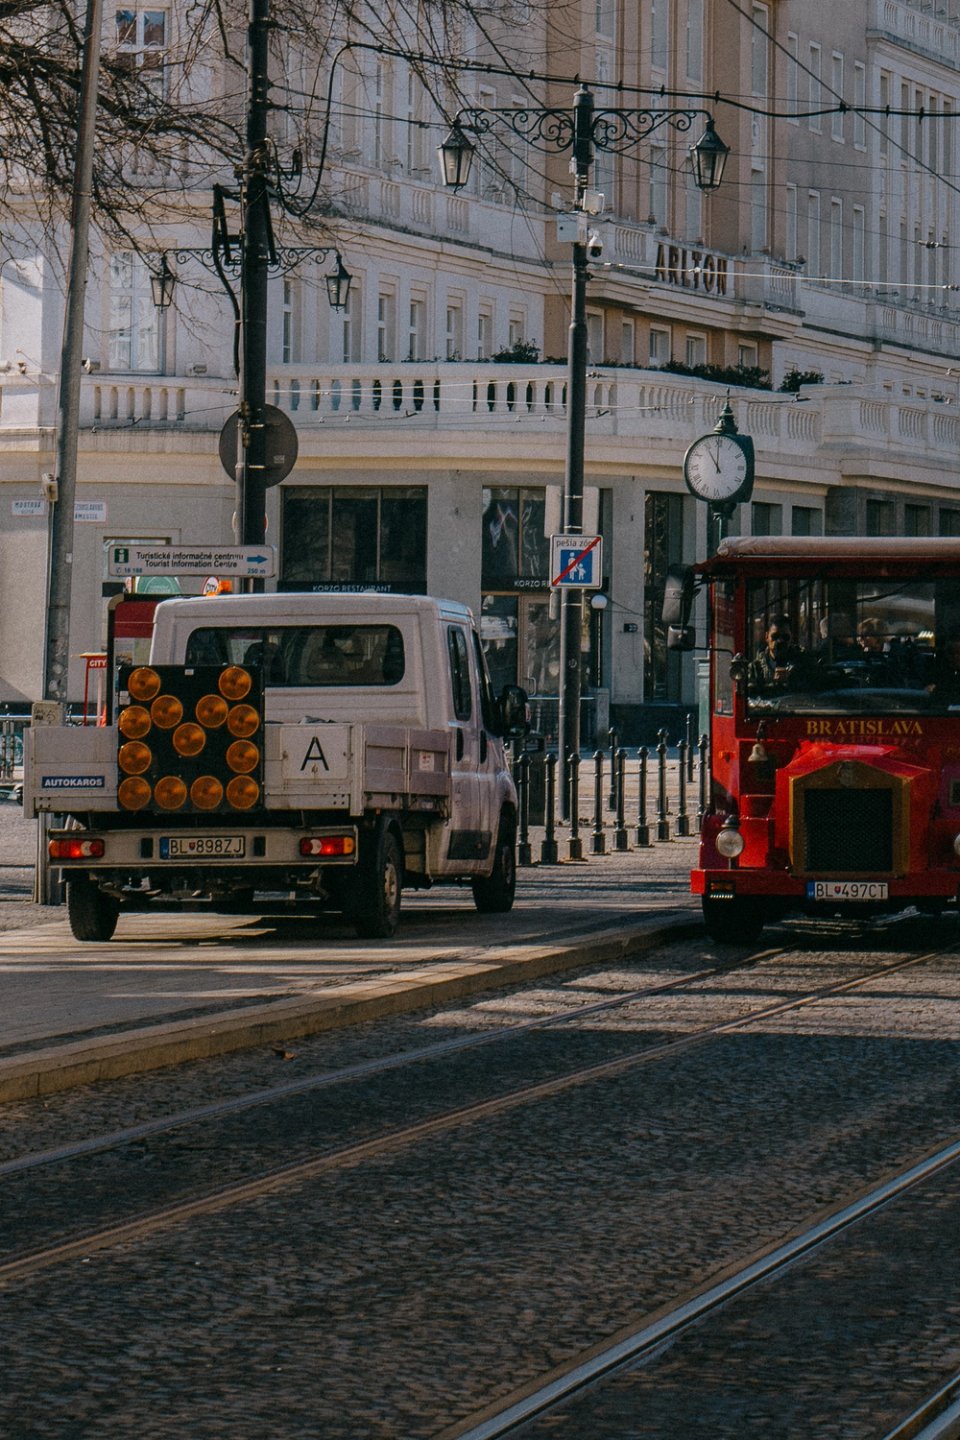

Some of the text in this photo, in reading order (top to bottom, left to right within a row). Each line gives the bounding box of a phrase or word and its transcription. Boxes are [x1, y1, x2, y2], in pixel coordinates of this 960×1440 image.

[556, 538, 577, 548] pešia
[136, 551, 171, 560] Turistické
[172, 551, 212, 560] informačné
[145, 560, 238, 568] Tourist Information Centre
[312, 584, 392, 592] KORZO RESTAURANT
[514, 580, 540, 588] KORZO
[89, 659, 107, 667] CITY
[806, 720, 924, 735] BRATISLAVA
[300, 735, 330, 771] A
[44, 777, 103, 787] AUTOKAROS
[170, 839, 242, 854] BL 898ZJ
[816, 883, 886, 898] BL 497CT
